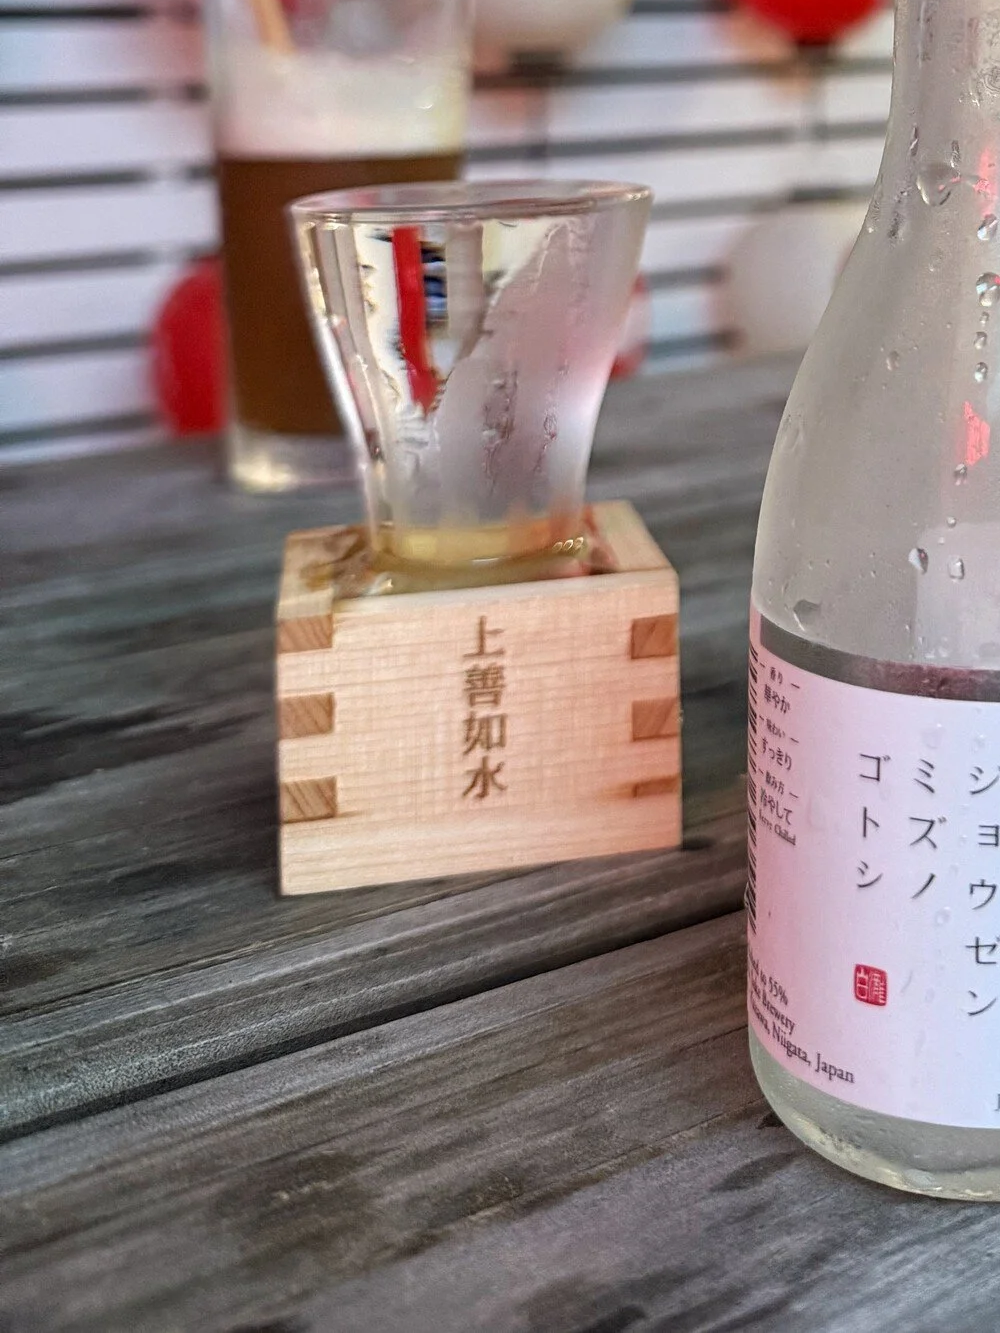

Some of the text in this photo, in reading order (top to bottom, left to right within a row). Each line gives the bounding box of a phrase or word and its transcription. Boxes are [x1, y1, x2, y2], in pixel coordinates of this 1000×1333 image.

[463, 616, 509, 799] 上善如水
[762, 736, 792, 771] すっきり
[857, 753, 891, 889] ゴトシ
[908, 758, 947, 899] ミズノ
[815, 1052, 855, 1084] Japan
